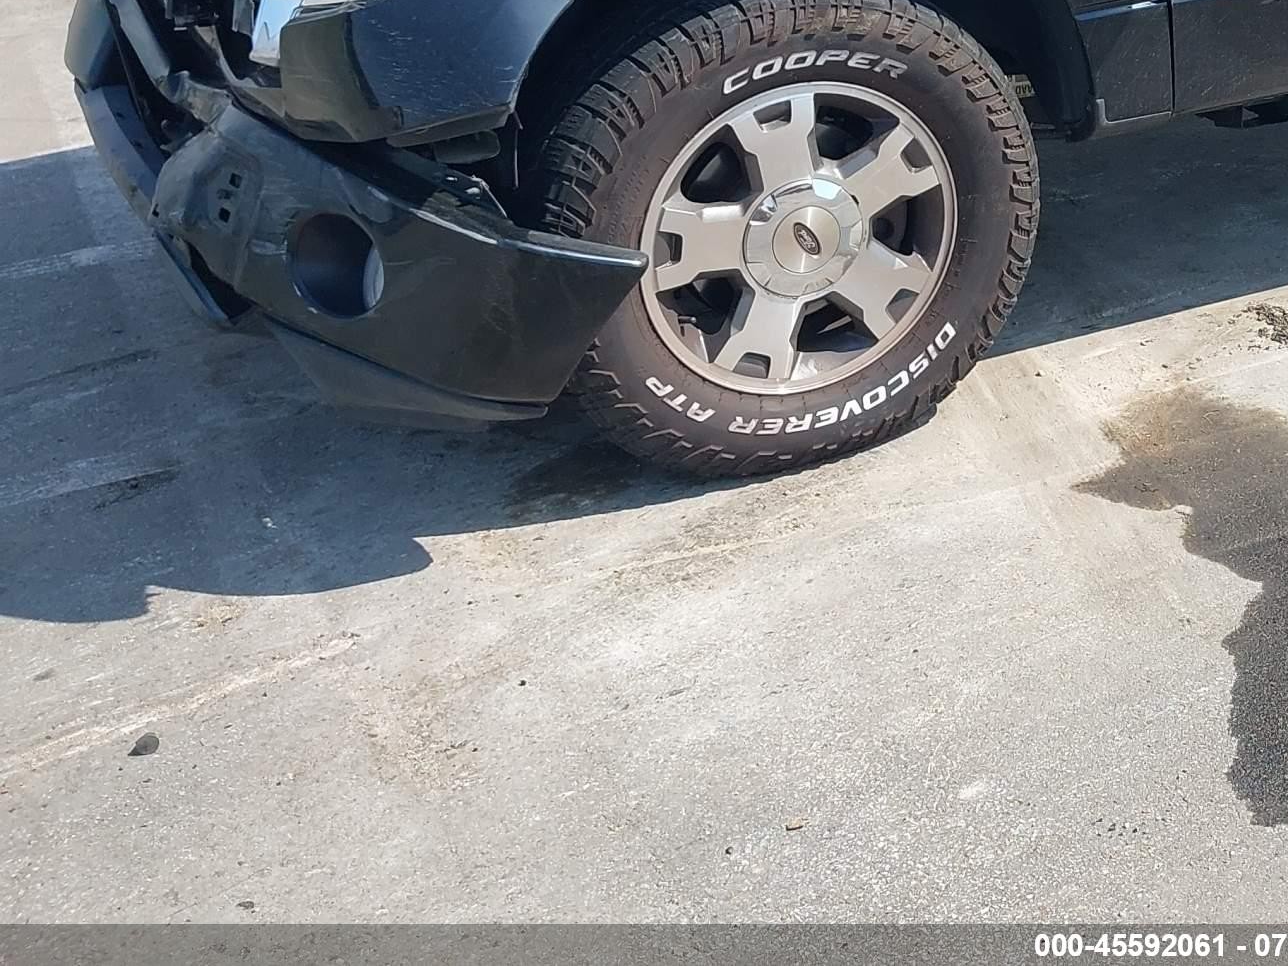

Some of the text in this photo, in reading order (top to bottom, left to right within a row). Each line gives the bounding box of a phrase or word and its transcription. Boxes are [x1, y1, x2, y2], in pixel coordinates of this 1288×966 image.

[722, 49, 907, 96] COOPER
[644, 322, 957, 435] DISCOVERER ATP
